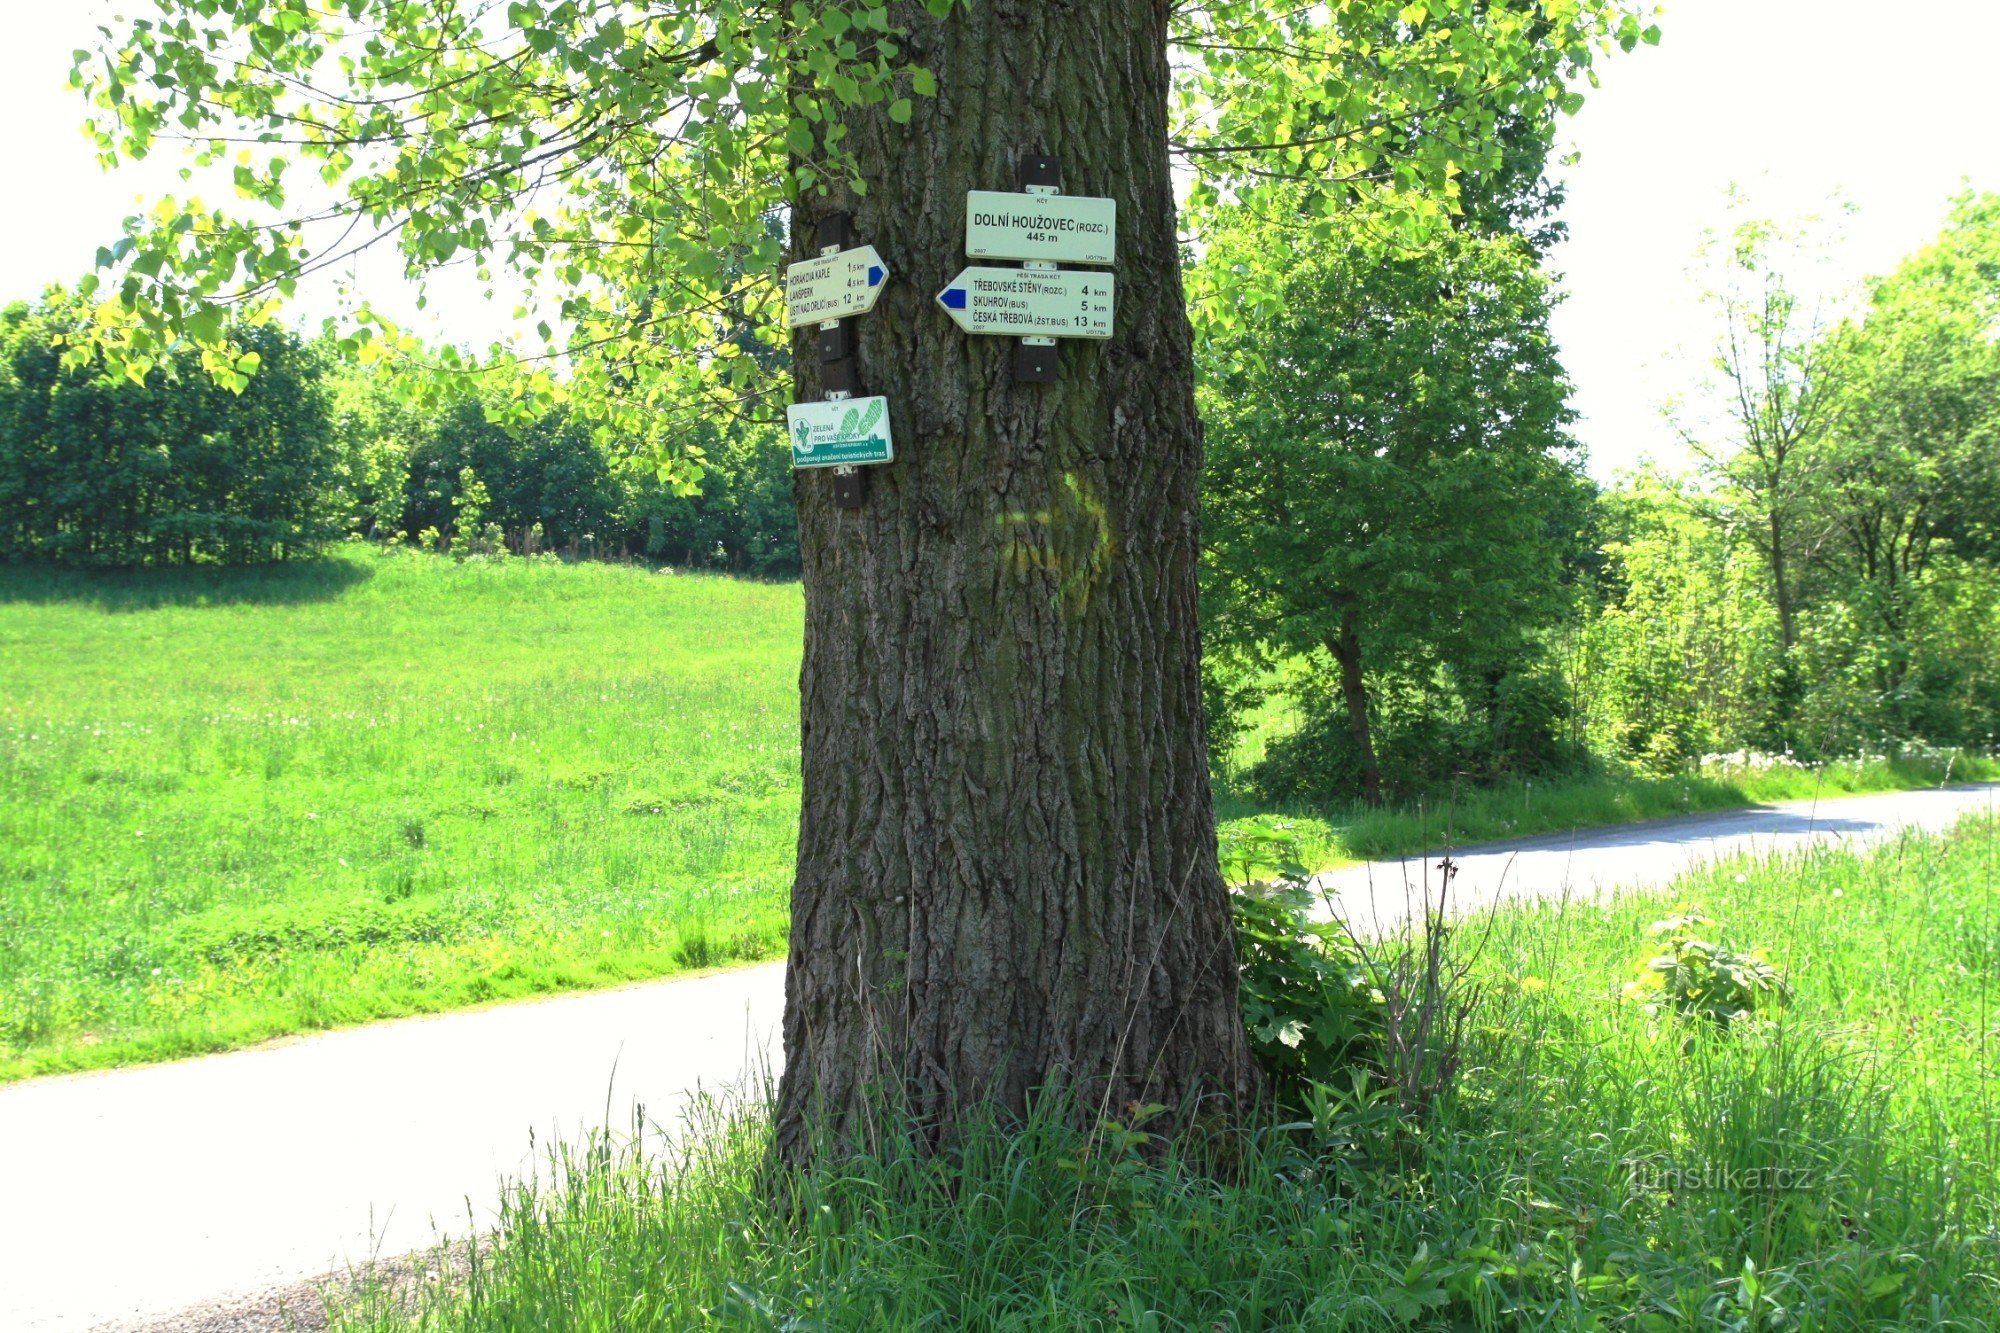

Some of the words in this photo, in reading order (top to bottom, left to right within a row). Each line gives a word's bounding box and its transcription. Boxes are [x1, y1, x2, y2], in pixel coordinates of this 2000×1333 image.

[974, 212, 1009, 227] DOLNÍ
[1012, 214, 1074, 231] HOUŽOVEC
[1076, 223, 1109, 235] (ROZC.)
[1026, 232, 1045, 242] 445
[1048, 234, 1058, 242] m
[815, 267, 830, 280] KAPLE
[847, 262, 856, 273] 1,5
[847, 277, 856, 288] 4,5
[973, 278, 1017, 293] TŘEBOVSKÉ
[1018, 280, 1042, 293] STĚNY
[1042, 286, 1067, 296] (ROZC.)
[789, 286, 814, 301] LANŠPERK
[1081, 285, 1089, 295] 4
[1094, 289, 1107, 297] km
[843, 294, 851, 304] 12
[973, 295, 1008, 307] SKUHROV
[1009, 300, 1028, 310] (BUS)
[801, 302, 810, 313] NAD
[826, 299, 839, 310] (BUS)
[1081, 301, 1088, 311] 5
[1094, 304, 1107, 312] km
[972, 309, 997, 322] ČESKÁ
[999, 310, 1033, 324] TŘEBOVÁ
[1073, 316, 1088, 327] 13
[1093, 320, 1106, 328] km
[813, 424, 834, 433] ZELENÁ
[826, 433, 840, 441] VAŠE
[841, 450, 873, 460] turistických
